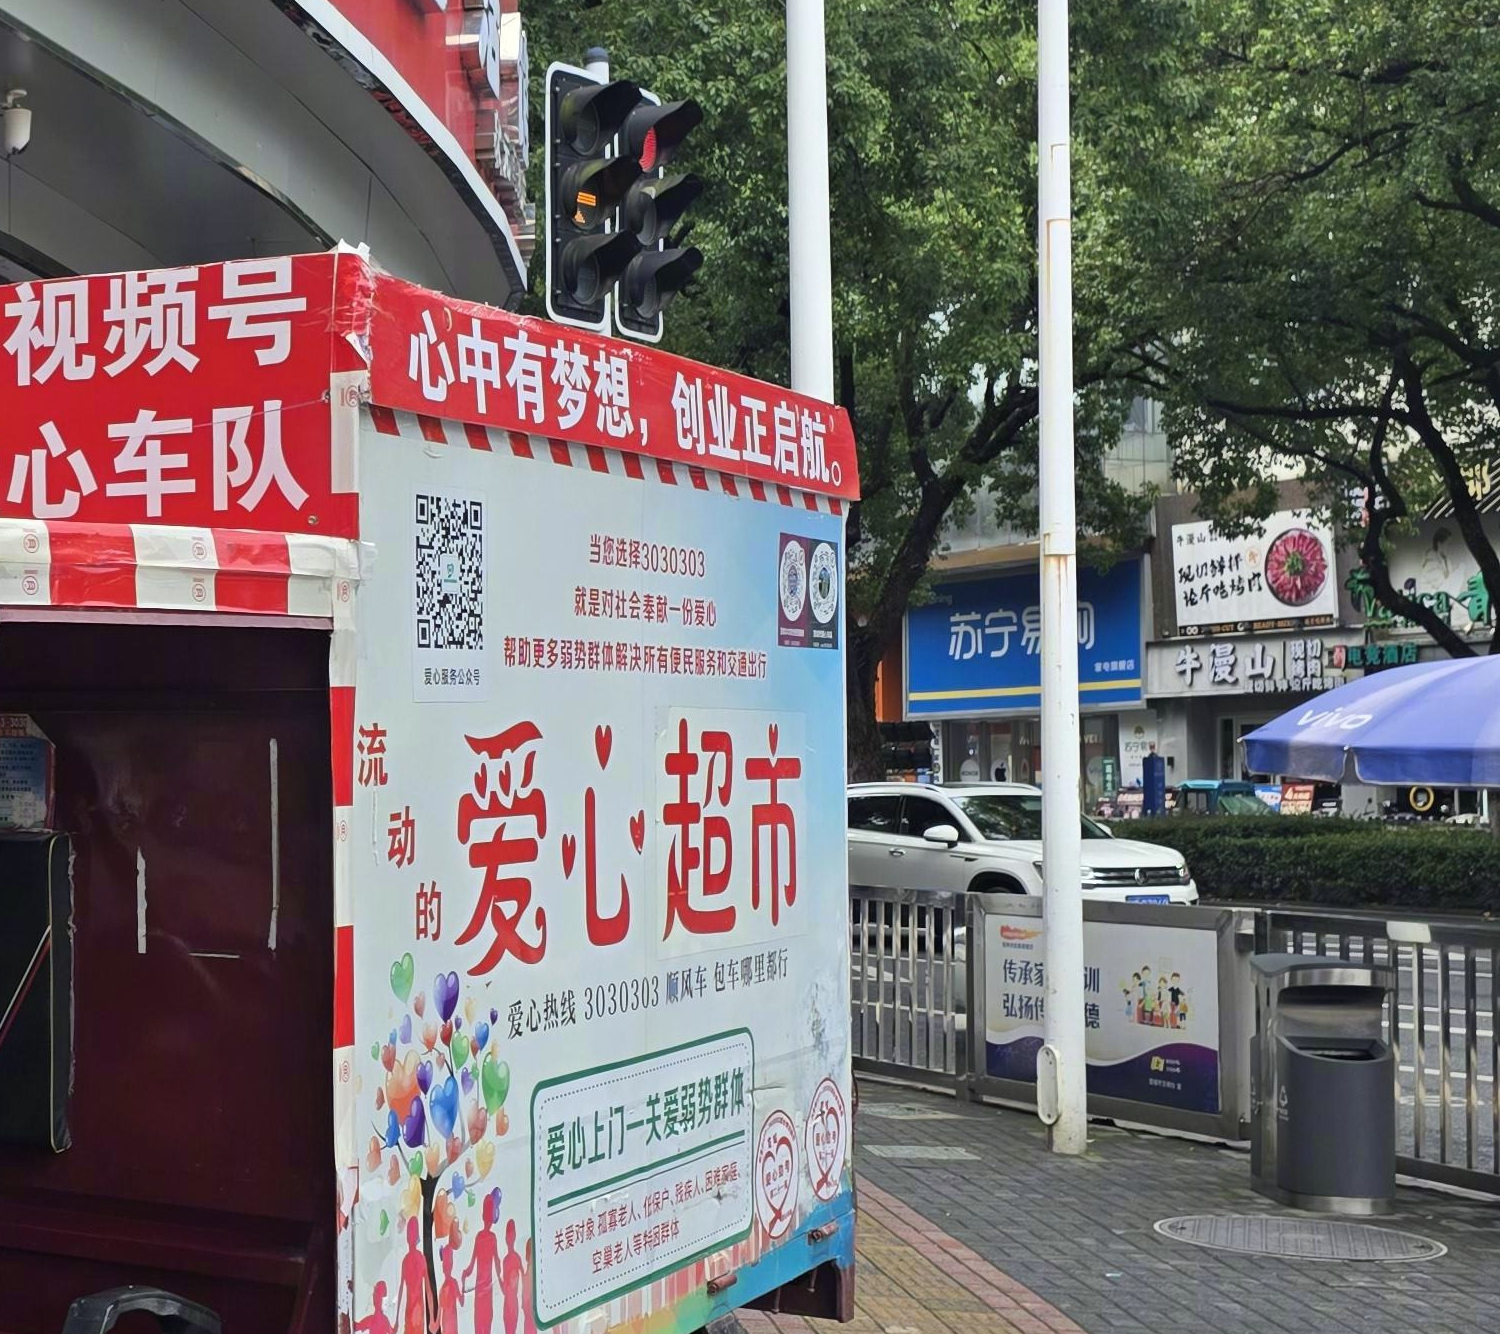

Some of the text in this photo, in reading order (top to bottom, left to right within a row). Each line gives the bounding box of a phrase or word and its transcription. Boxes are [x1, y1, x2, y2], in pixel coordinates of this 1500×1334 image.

[408, 309, 842, 487] 心中有梦想，创业正启航。
[589, 533, 706, 578] 当您选择3030303
[573, 585, 717, 627] 就是对社会奉献一份爱心
[424, 667, 480, 685] 爱心服务公众号
[503, 635, 768, 679] 帮助更多弱势群体解决所有便民服务和交通出行
[1175, 642, 1276, 686] 牛漫山
[1297, 707, 1373, 730] vivo
[454, 718, 802, 977] 爱心超市
[507, 947, 789, 1040] 爱心热线 3030303 顺风车 包车哪里都行
[1003, 958, 1100, 994] 传承家训
[1003, 993, 1100, 1029] 弘扬传德
[554, 1217, 596, 1255] 关爱对象
[591, 1217, 680, 1275] 空巢老人等特困群体
